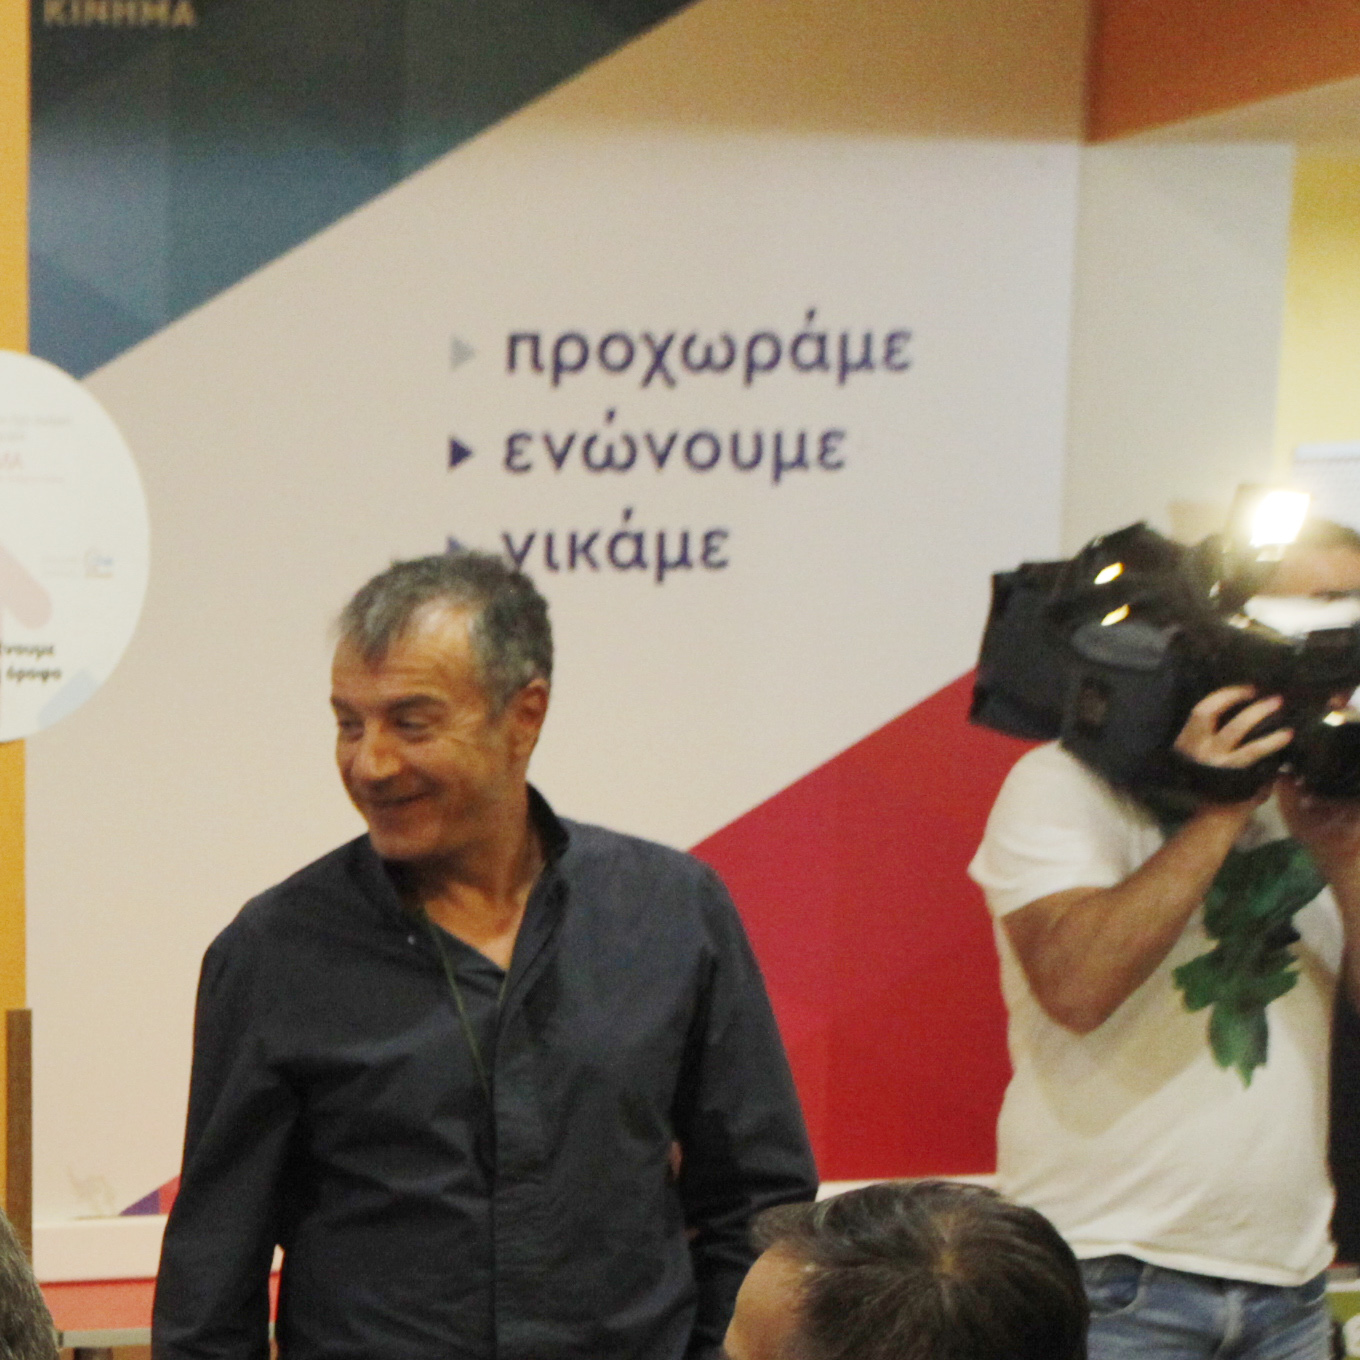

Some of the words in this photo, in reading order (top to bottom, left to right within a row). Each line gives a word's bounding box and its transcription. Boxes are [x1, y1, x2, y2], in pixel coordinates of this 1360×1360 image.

[505, 307, 914, 389] προχωράμε
[502, 407, 848, 487] ενώνουμε
[500, 505, 733, 585] νικάμε
